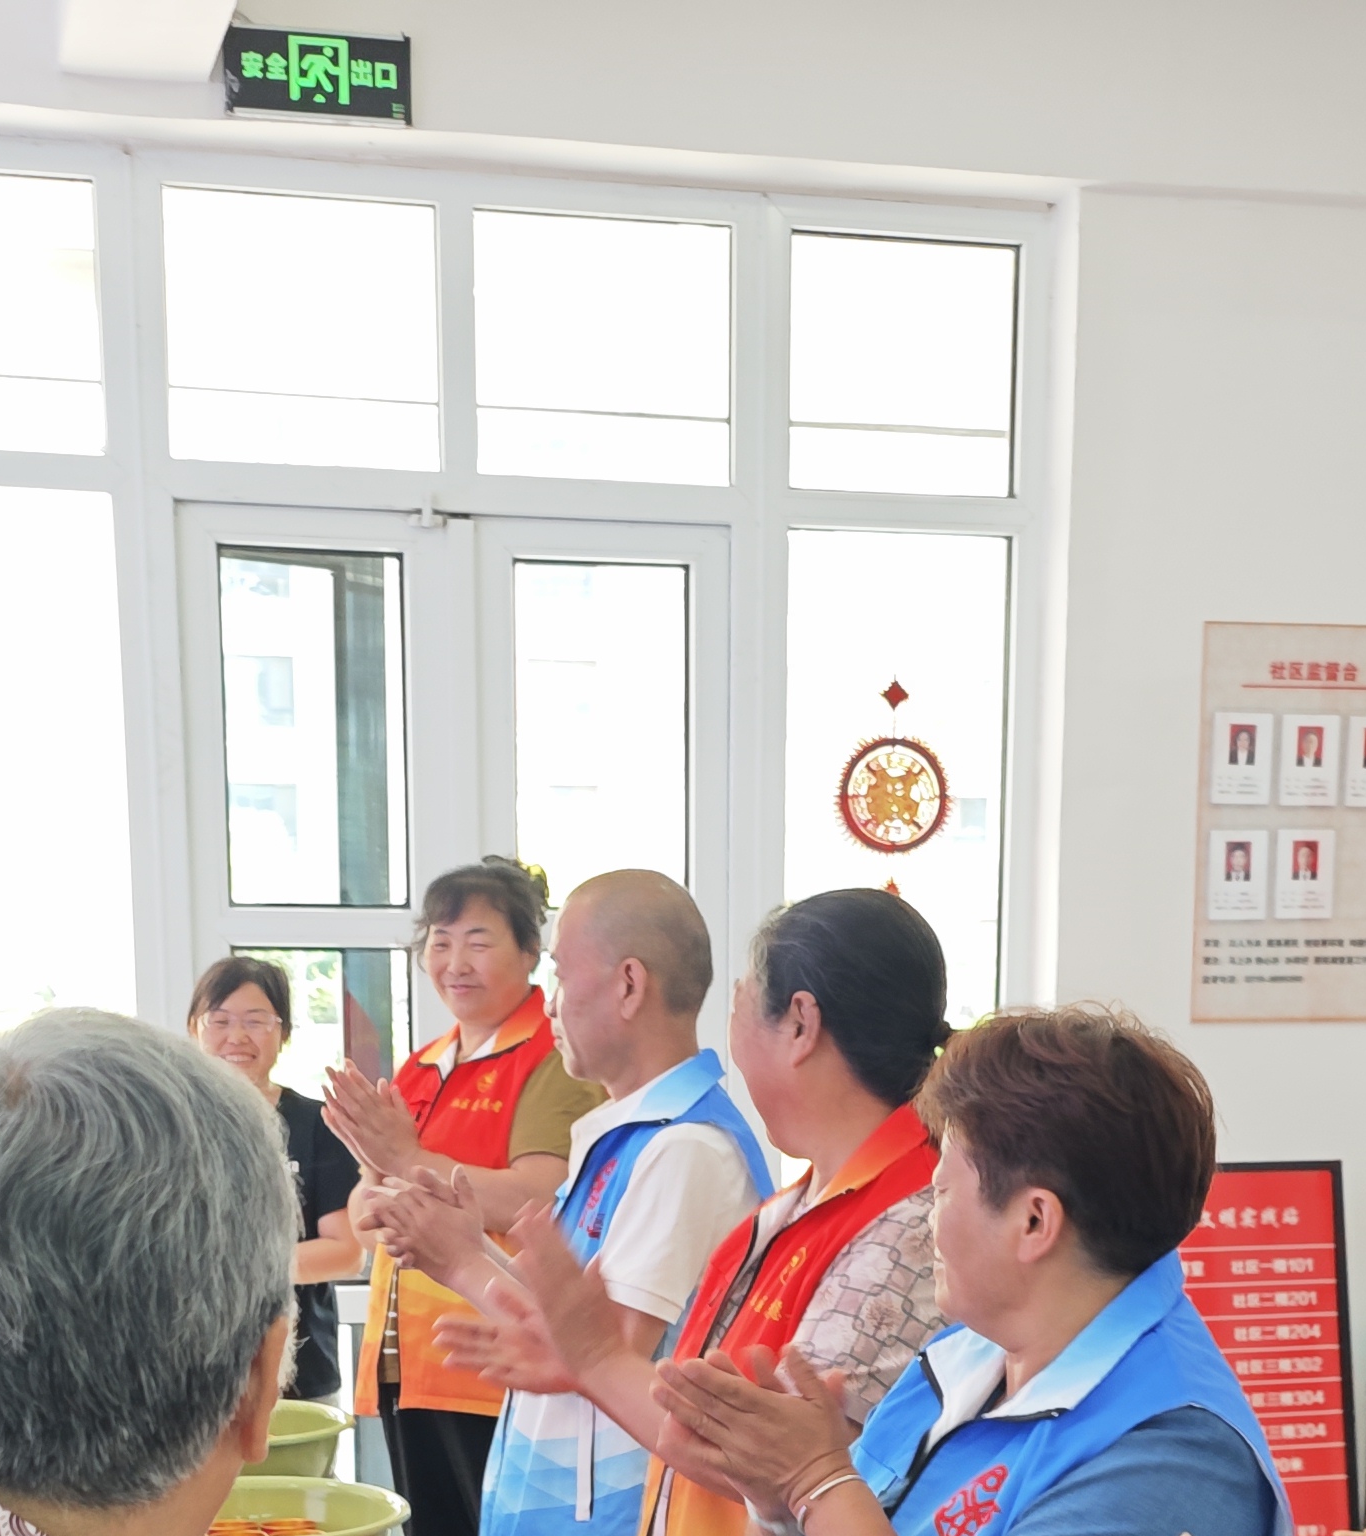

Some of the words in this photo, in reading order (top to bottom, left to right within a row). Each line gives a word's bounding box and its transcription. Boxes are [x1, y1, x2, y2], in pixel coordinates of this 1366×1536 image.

[241, 51, 287, 80] 安全
[351, 59, 397, 89] 出口
[1269, 660, 1358, 683] 社区监督台
